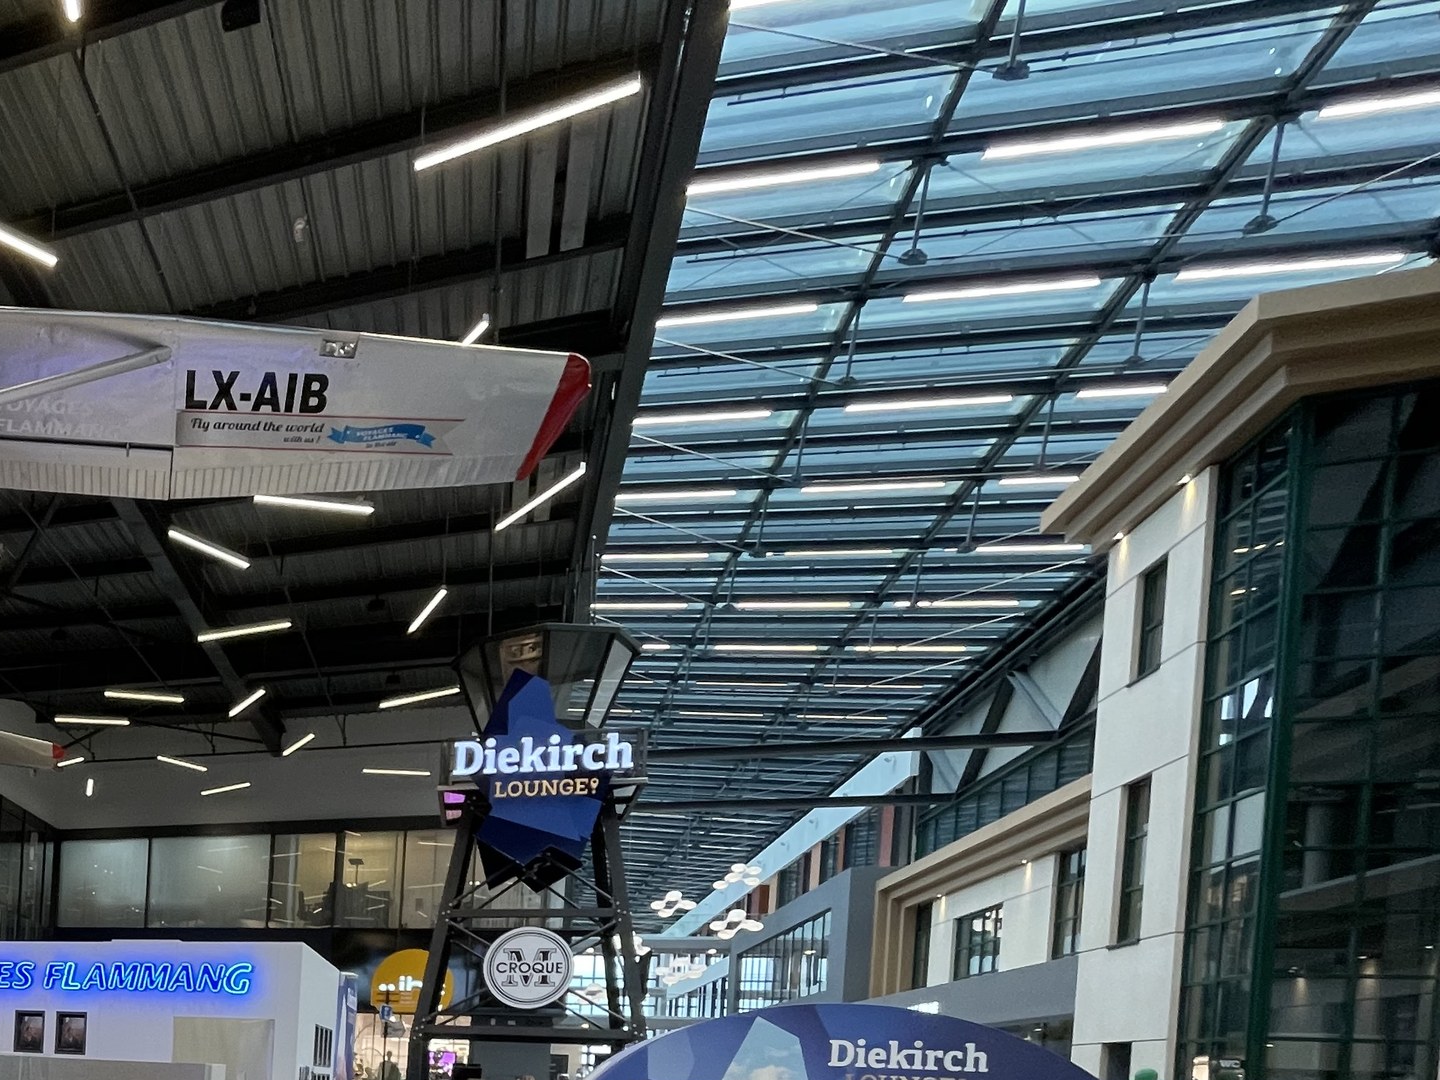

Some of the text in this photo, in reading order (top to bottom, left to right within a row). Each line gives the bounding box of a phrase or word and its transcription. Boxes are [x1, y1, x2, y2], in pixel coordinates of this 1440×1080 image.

[184, 369, 330, 414] LX-AIB
[191, 418, 325, 433] Fly around the world
[452, 732, 635, 776] Diekirch
[43, 961, 253, 995] FLAMMANG
[495, 961, 564, 975] CROQUE
[827, 1038, 989, 1073] Diekirch
